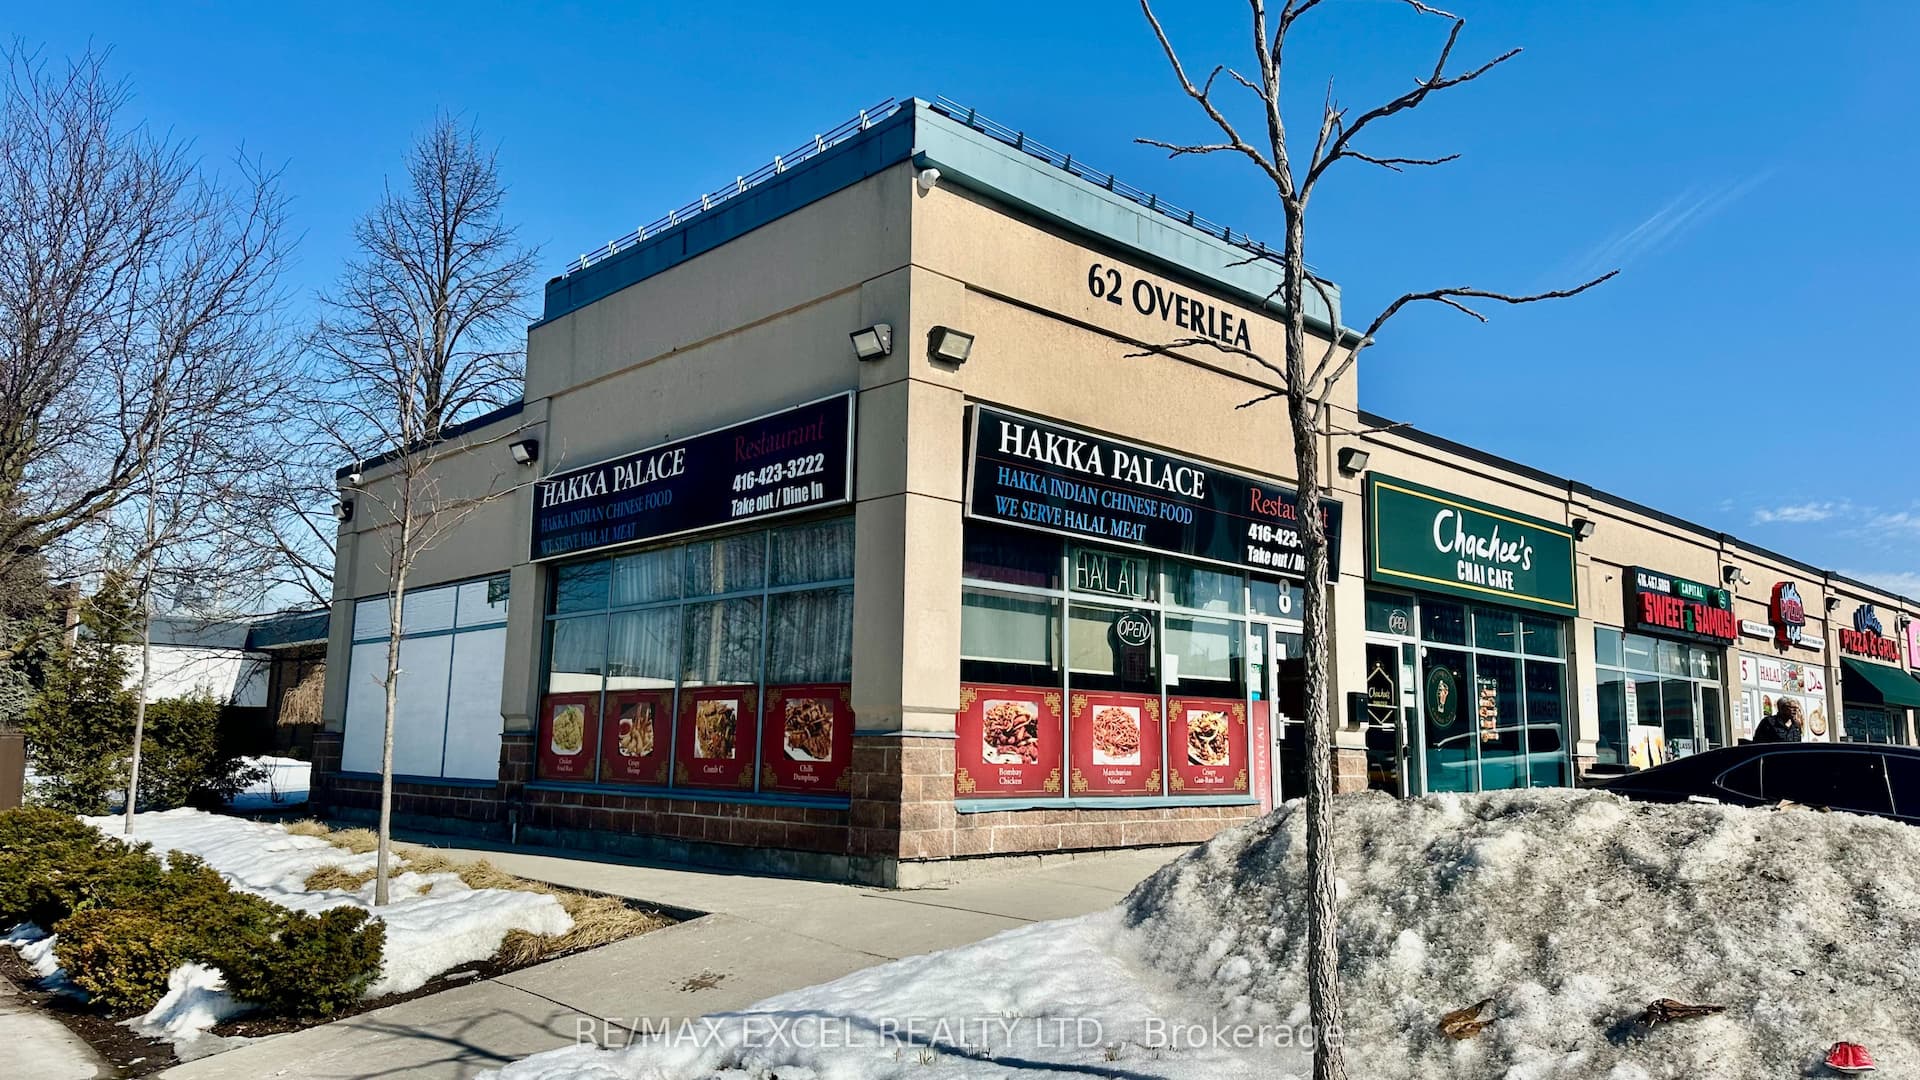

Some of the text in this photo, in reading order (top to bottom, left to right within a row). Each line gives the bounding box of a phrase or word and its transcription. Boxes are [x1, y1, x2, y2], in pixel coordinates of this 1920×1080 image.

[1088, 264, 1251, 351] 62 OVERLEA
[735, 415, 824, 463] Restaurant
[732, 453, 824, 492] 416-423-3222
[998, 421, 1205, 499] HAKKA PALACE
[542, 448, 686, 508] HAKKA PALACE
[541, 489, 673, 534] HAKKA INDIAN CHINESE FOOD
[732, 481, 823, 517] Take out / Dine In
[997, 466, 1193, 525] HAKKA INDIAN CHINESE FOOD
[1250, 488, 1328, 528] Restaut
[995, 495, 1146, 542] WE SERVE HALAL MEAT
[541, 522, 637, 554] WE SERVE HALAL MEAT
[1432, 509, 1532, 571] Chachee's
[1077, 551, 1143, 597] HALAL
[1247, 545, 1305, 572] Take out / Di
[1457, 559, 1514, 591] CHAI CAFE
[1681, 583, 1704, 598] CAPITAL
[1279, 579, 1292, 613] 8
[1119, 620, 1149, 637] OPEN
[1391, 616, 1407, 630] OPEN
[1643, 592, 1684, 630] SWEET
[1694, 604, 1737, 639] SAMOSA
[1842, 629, 1869, 655] PIZZA
[1878, 638, 1901, 660] GRILL
[1742, 660, 1748, 681] 5
[1760, 666, 1781, 683] HALAL
[793, 773, 819, 783] Dumplings
[998, 768, 1022, 777] Bombay
[998, 777, 1022, 785] Chicken
[1102, 768, 1132, 777] Manchurian
[1107, 777, 1126, 785] Noodle
[1202, 768, 1216, 777] Crispy
